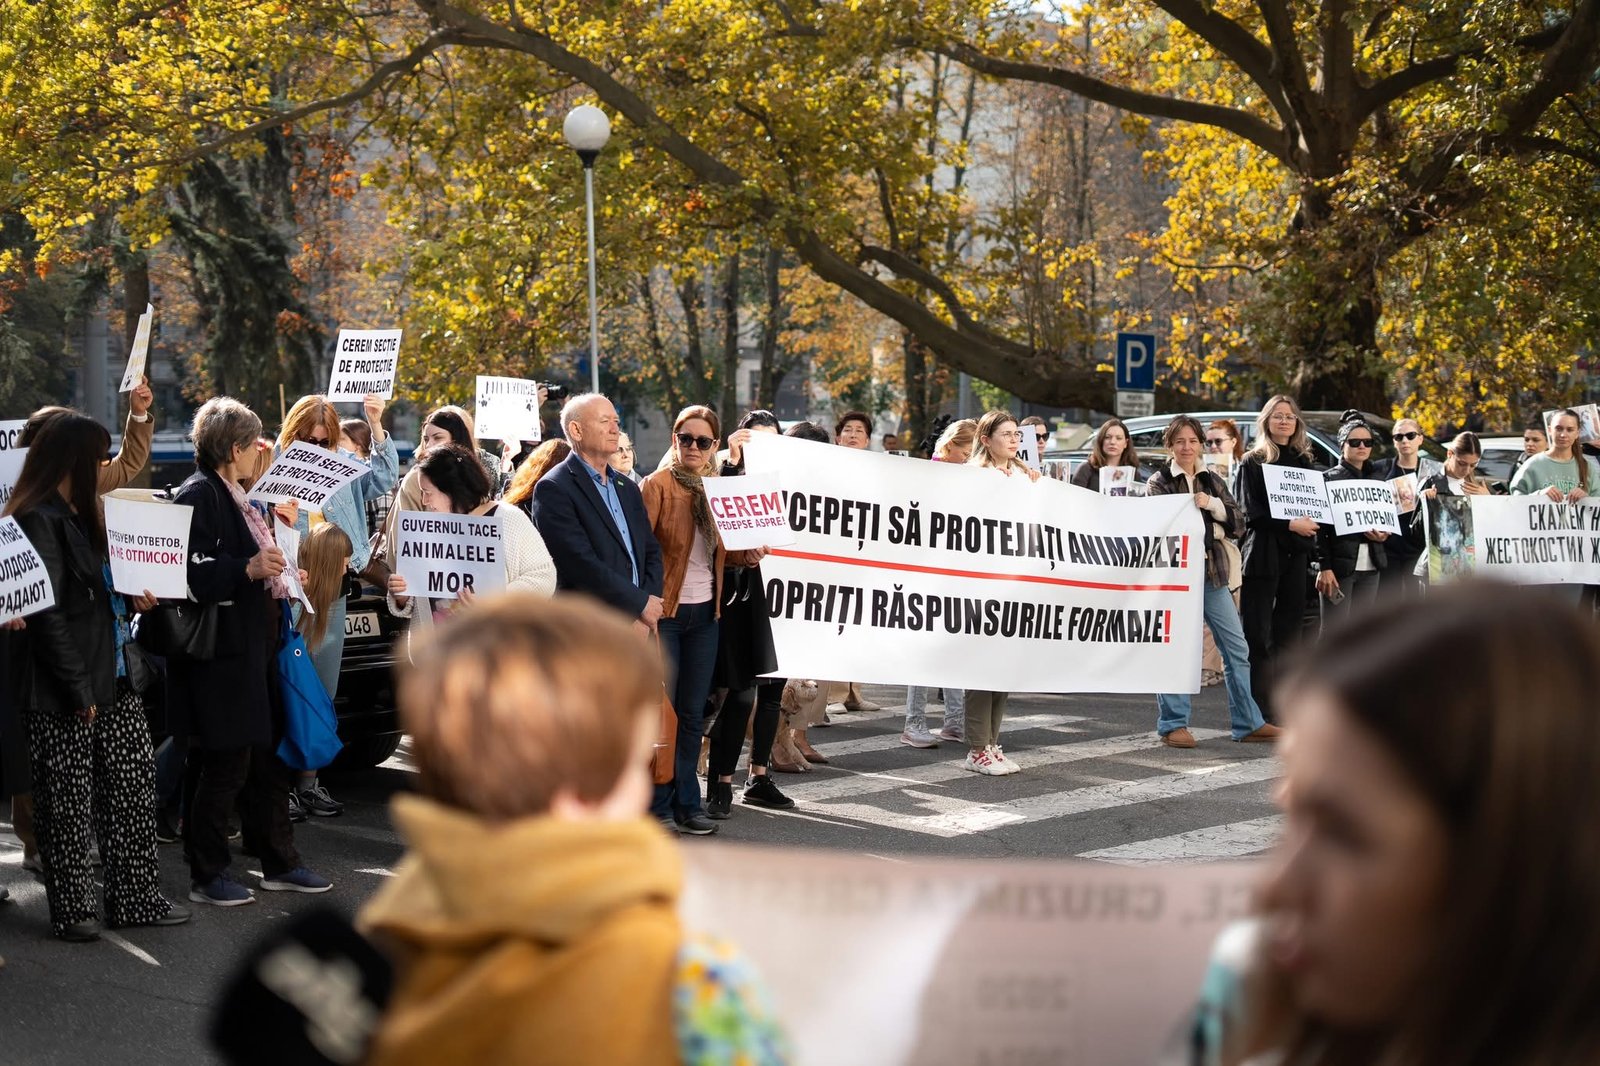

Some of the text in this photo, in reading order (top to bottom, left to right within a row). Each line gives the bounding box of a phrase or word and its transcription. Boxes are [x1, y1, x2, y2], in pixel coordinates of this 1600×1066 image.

[342, 338, 372, 352] CEREM
[339, 359, 352, 373] DE
[1126, 340, 1147, 383] P
[334, 379, 391, 394] A ANIMALELOR
[285, 448, 321, 465] CEREM
[270, 464, 288, 476] DE
[255, 481, 326, 505] A ANIMALELOR
[1279, 482, 1317, 495] AUTORITATE
[1331, 486, 1393, 505] ЖИВОДЕРОВ
[710, 492, 782, 519] CEREM
[1270, 493, 1295, 505] PENTRU
[717, 516, 786, 531] PEDEPSE ASPRE!
[1283, 508, 1323, 520] ANIMALELOR
[1345, 510, 1396, 527] В ТЮРЬМУ
[1528, 503, 1585, 531] СКАЖЕМ
[108, 529, 183, 549] ТРЕБУЕМ ОТВЕТОВ,
[402, 518, 501, 541] GUVERNUL TACE,
[781, 490, 881, 551] CEPEȚI
[887, 500, 922, 547] SĂ
[929, 511, 1065, 571] PROTEJAȚI
[110, 545, 183, 565] А НЕ ОТПИСОК!
[401, 541, 496, 563] ANIMALELE
[428, 571, 475, 594] MOR
[766, 577, 1172, 644] OPRIȚI RĂSPUNSURILE FORMALE!
